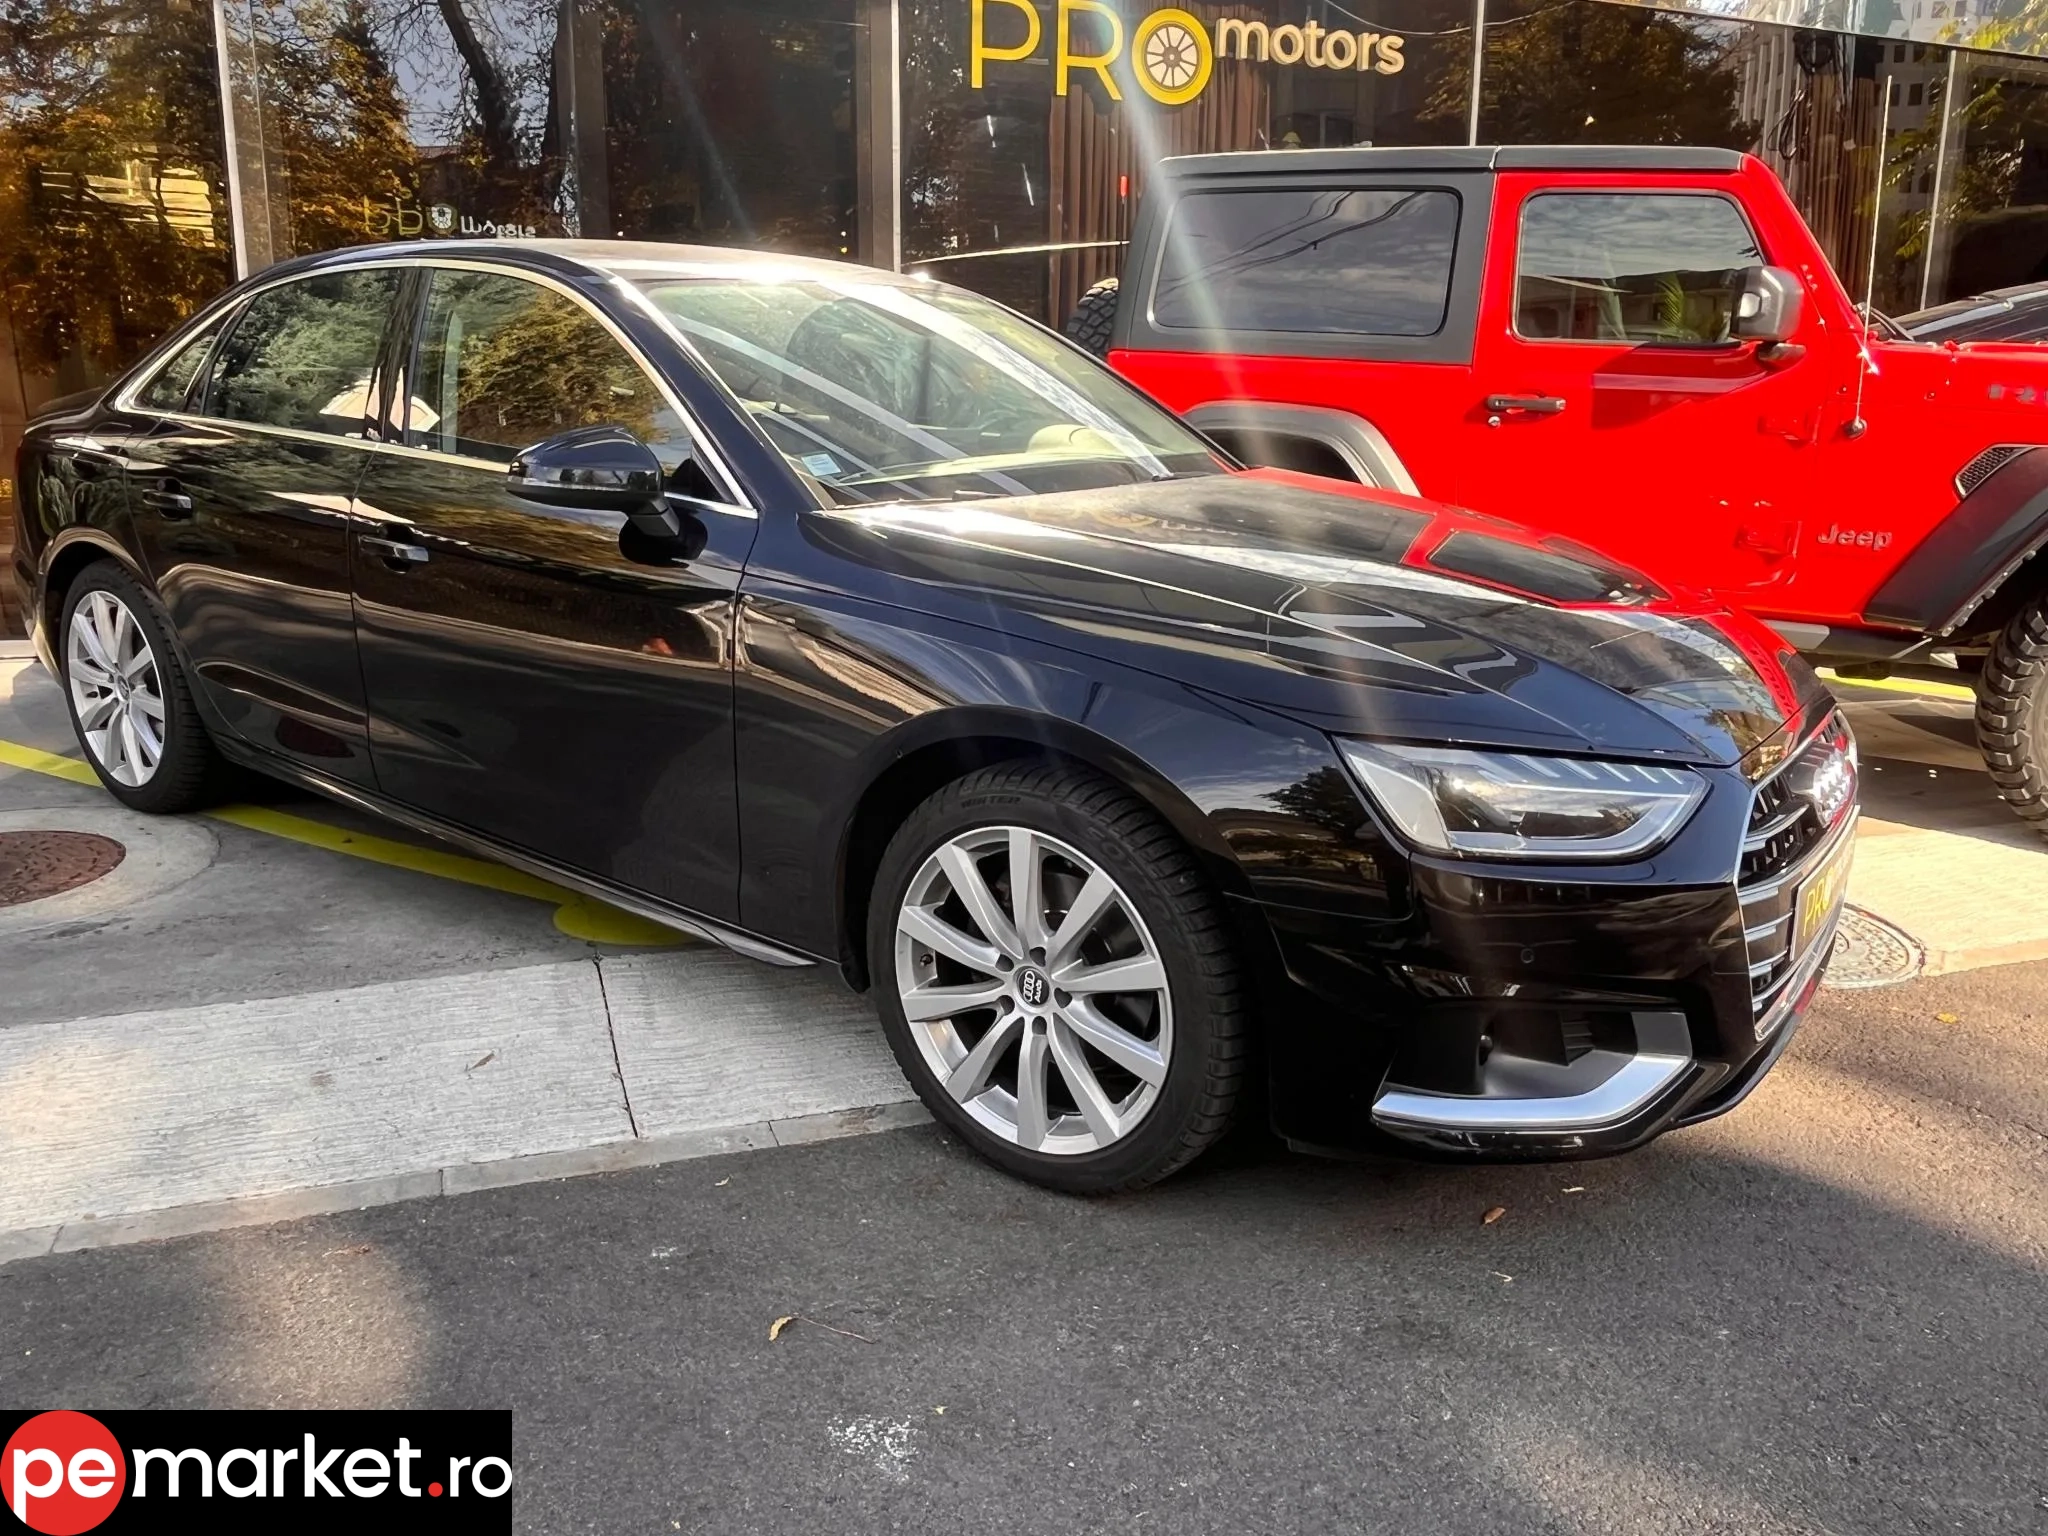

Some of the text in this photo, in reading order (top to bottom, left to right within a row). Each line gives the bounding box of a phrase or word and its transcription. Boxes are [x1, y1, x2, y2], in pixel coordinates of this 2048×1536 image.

[1215, 17, 1405, 75] motors
[1818, 522, 1892, 551] Jeep
[960, 795, 1022, 809] WINTER
